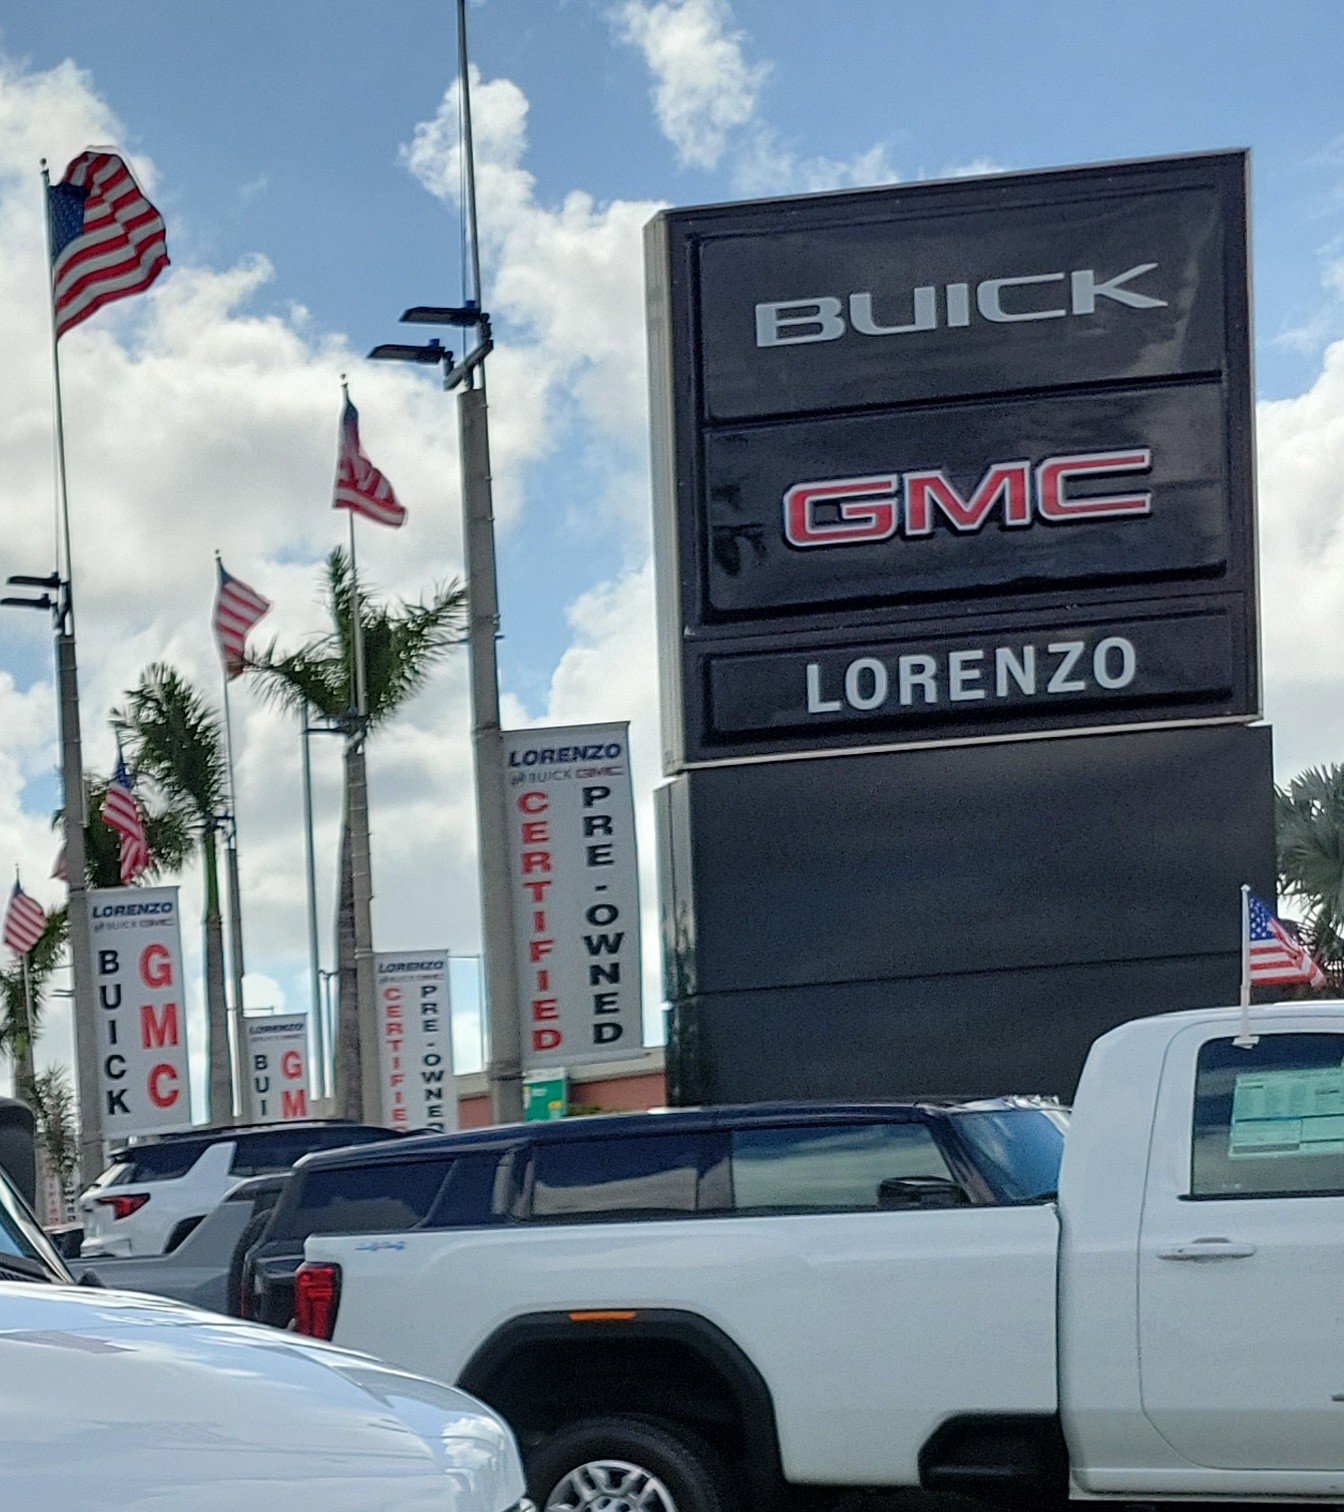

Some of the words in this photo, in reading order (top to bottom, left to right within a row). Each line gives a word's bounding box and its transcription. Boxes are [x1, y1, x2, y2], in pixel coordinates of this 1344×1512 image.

[755, 263, 1168, 348] BUICK
[783, 448, 1151, 547] GMC
[806, 636, 1136, 714] LORENZO
[509, 743, 622, 768] LORENZO
[92, 902, 173, 918] LORENZO
[518, 791, 562, 1051] CERTIFIED
[98, 949, 130, 1115] BUICK
[139, 943, 180, 1108] GMC
